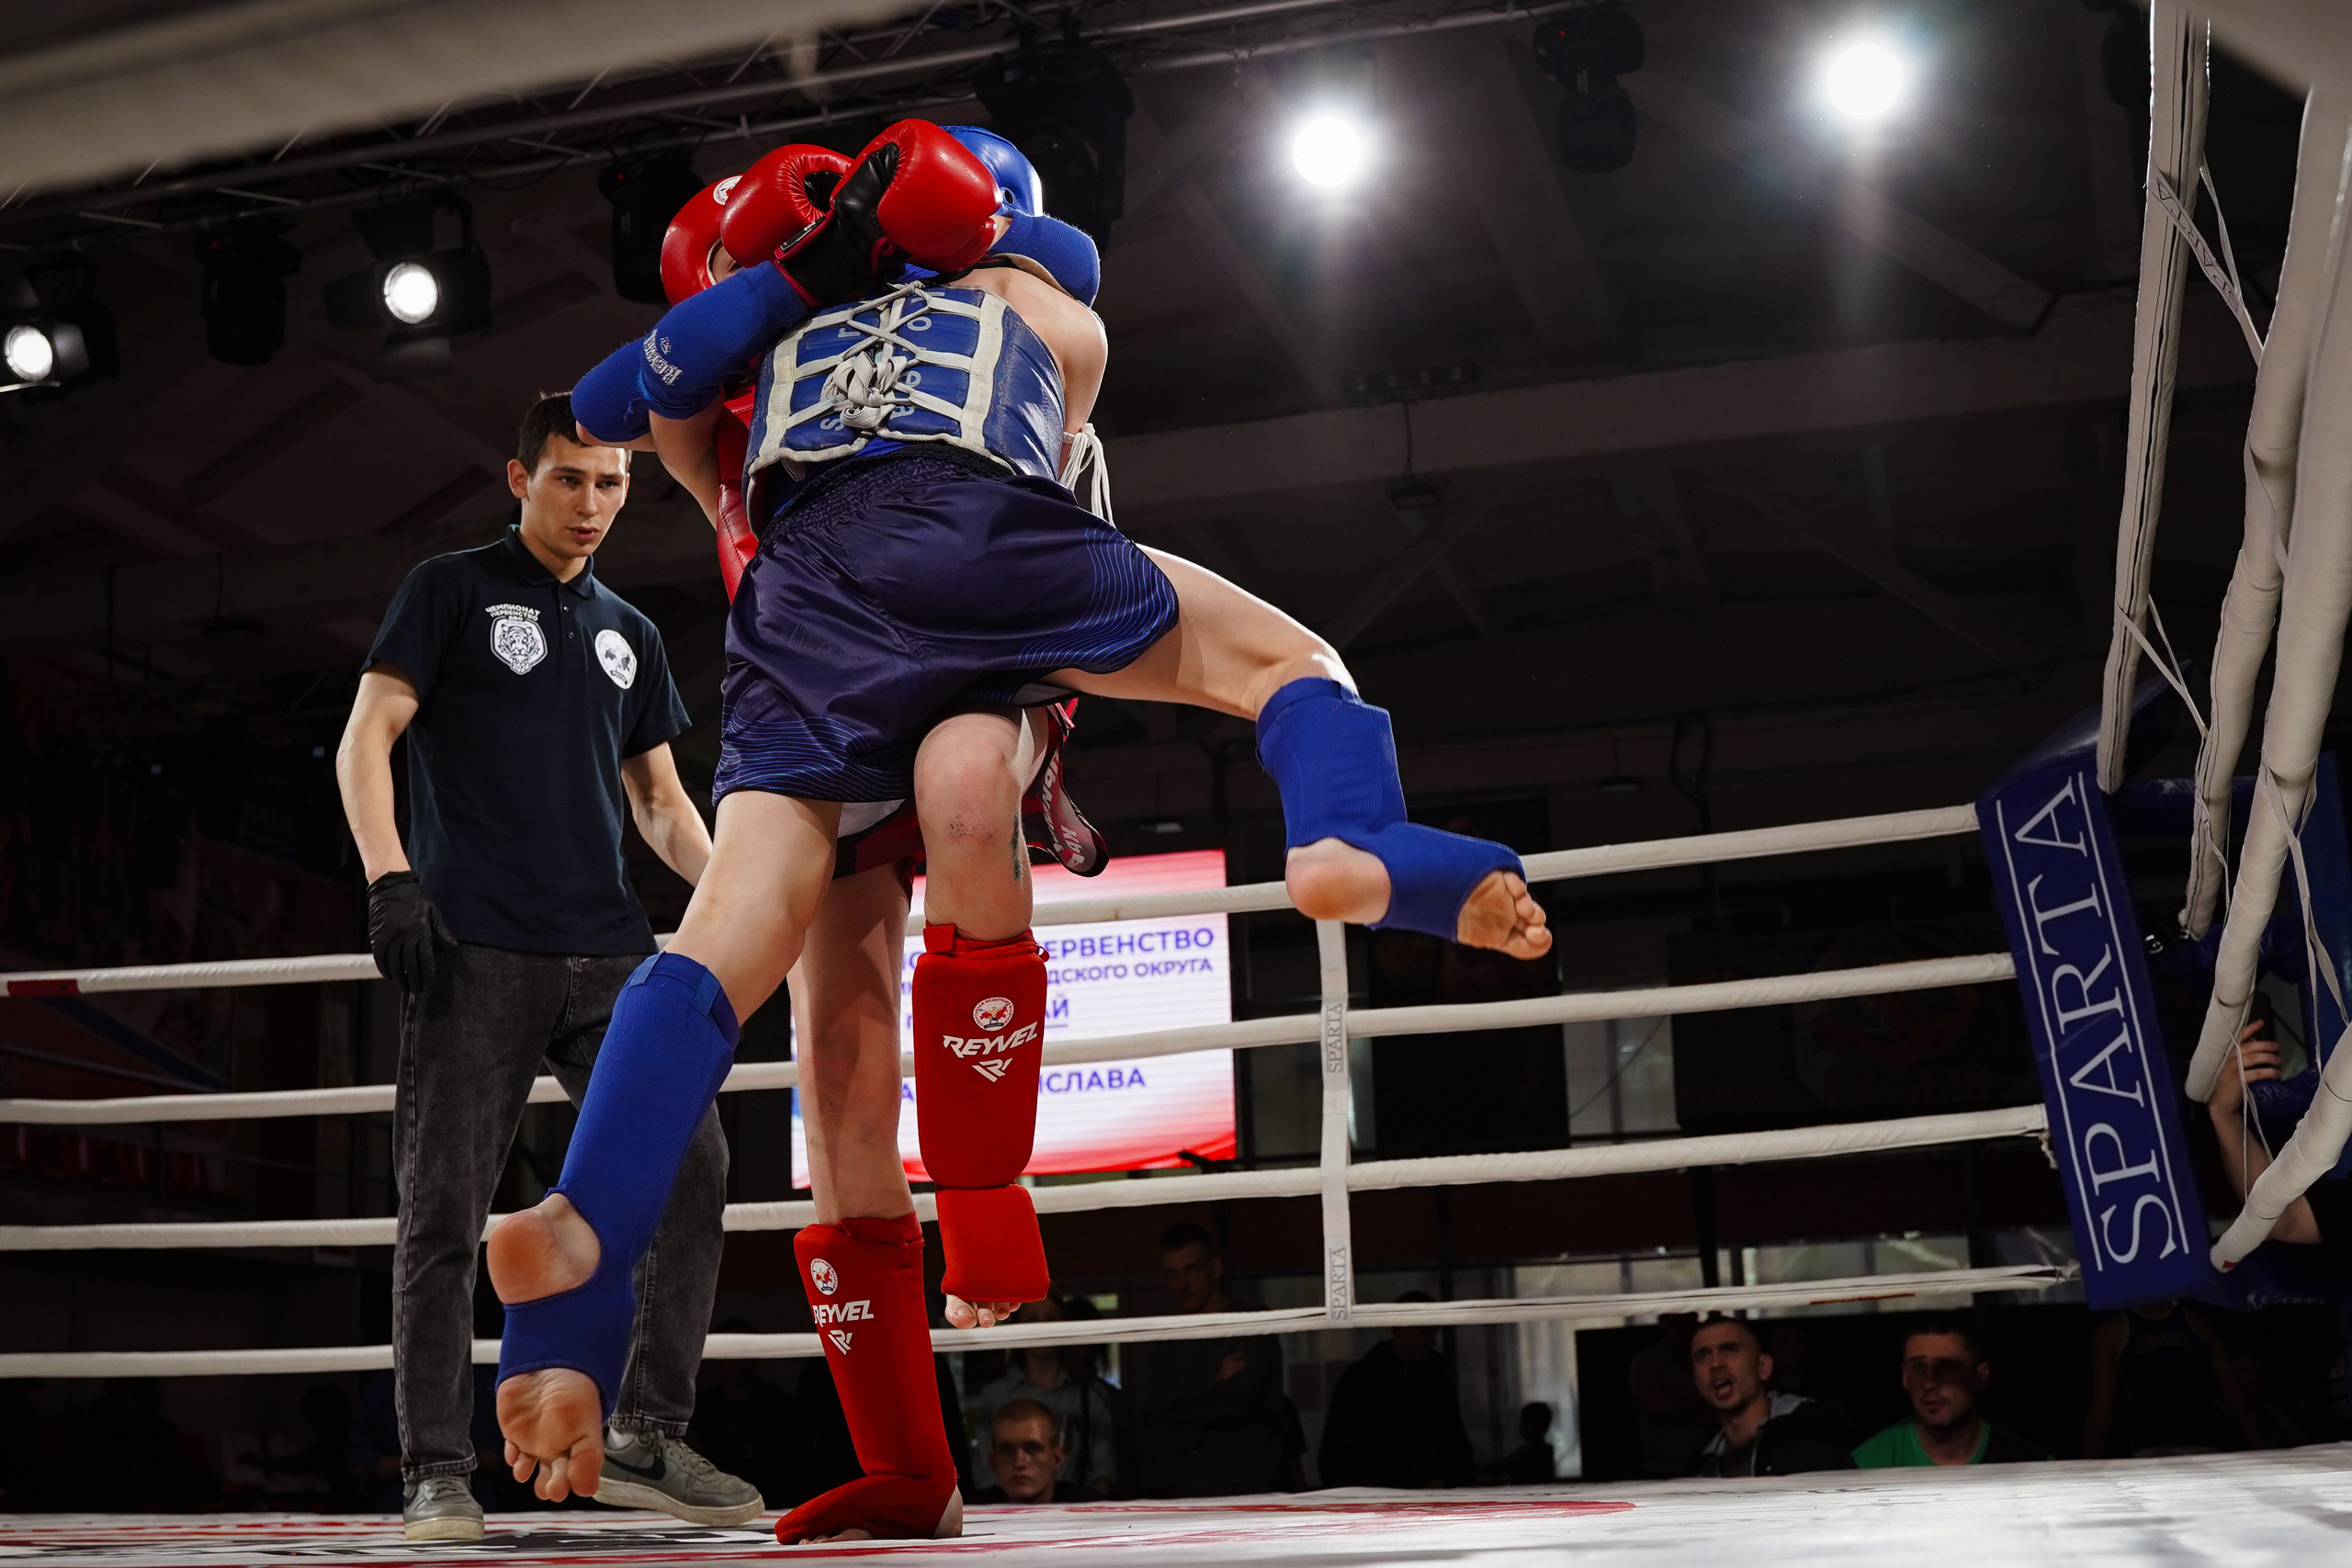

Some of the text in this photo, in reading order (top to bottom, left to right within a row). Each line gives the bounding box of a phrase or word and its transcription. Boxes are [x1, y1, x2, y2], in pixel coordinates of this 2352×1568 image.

[485, 604, 540, 616] ЧЕМПИОНАТ
[1040, 928, 1215, 960] ЕРВЕНСТВО
[1047, 958, 1213, 985] ДСКОГО ОКРУГА
[2014, 775, 2177, 1266] SPARTA
[1328, 1003, 1342, 1073] SPARTA
[1039, 1068, 1146, 1094] СЛАВА
[1332, 1247, 1347, 1320] SPARTA
